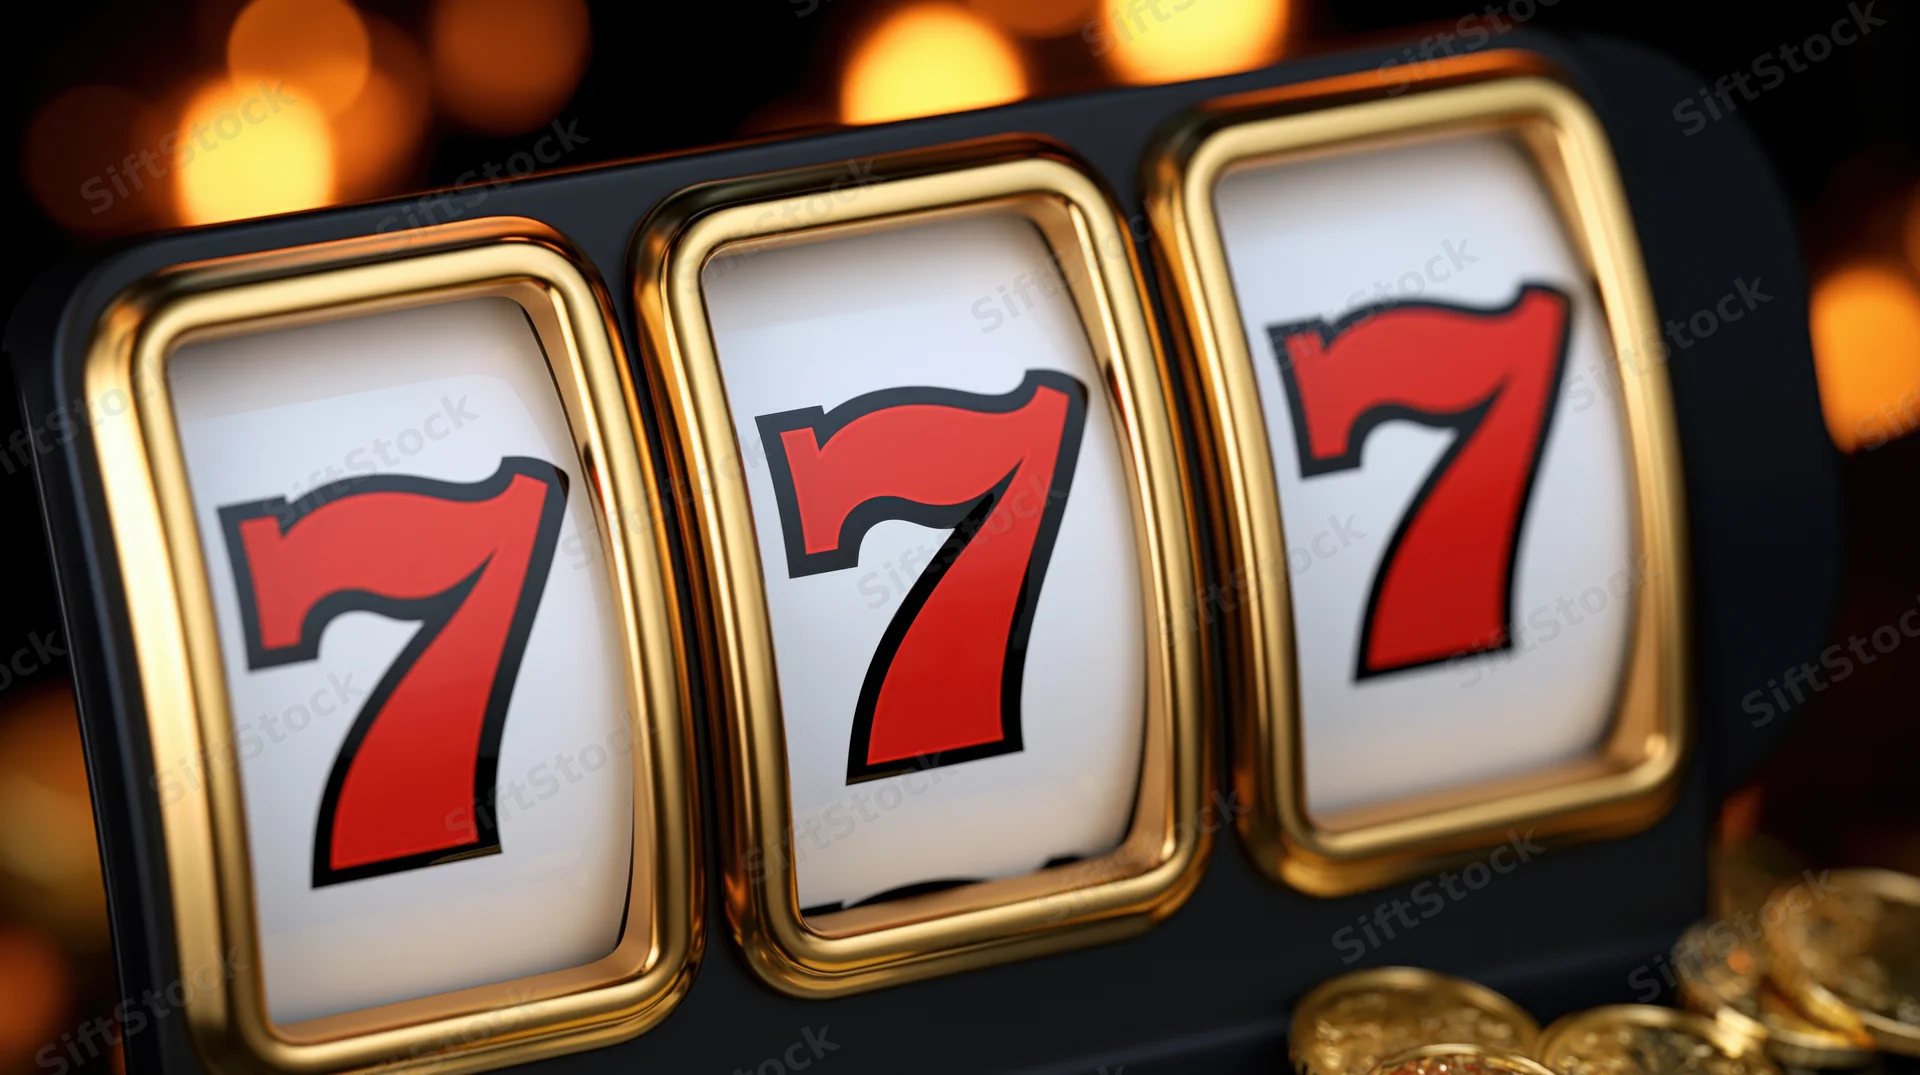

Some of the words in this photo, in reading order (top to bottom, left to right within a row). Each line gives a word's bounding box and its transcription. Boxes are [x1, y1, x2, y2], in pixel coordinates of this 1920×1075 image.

[218, 456, 569, 889] 7
[754, 369, 1089, 785] 7
[1266, 281, 1573, 684] 7
